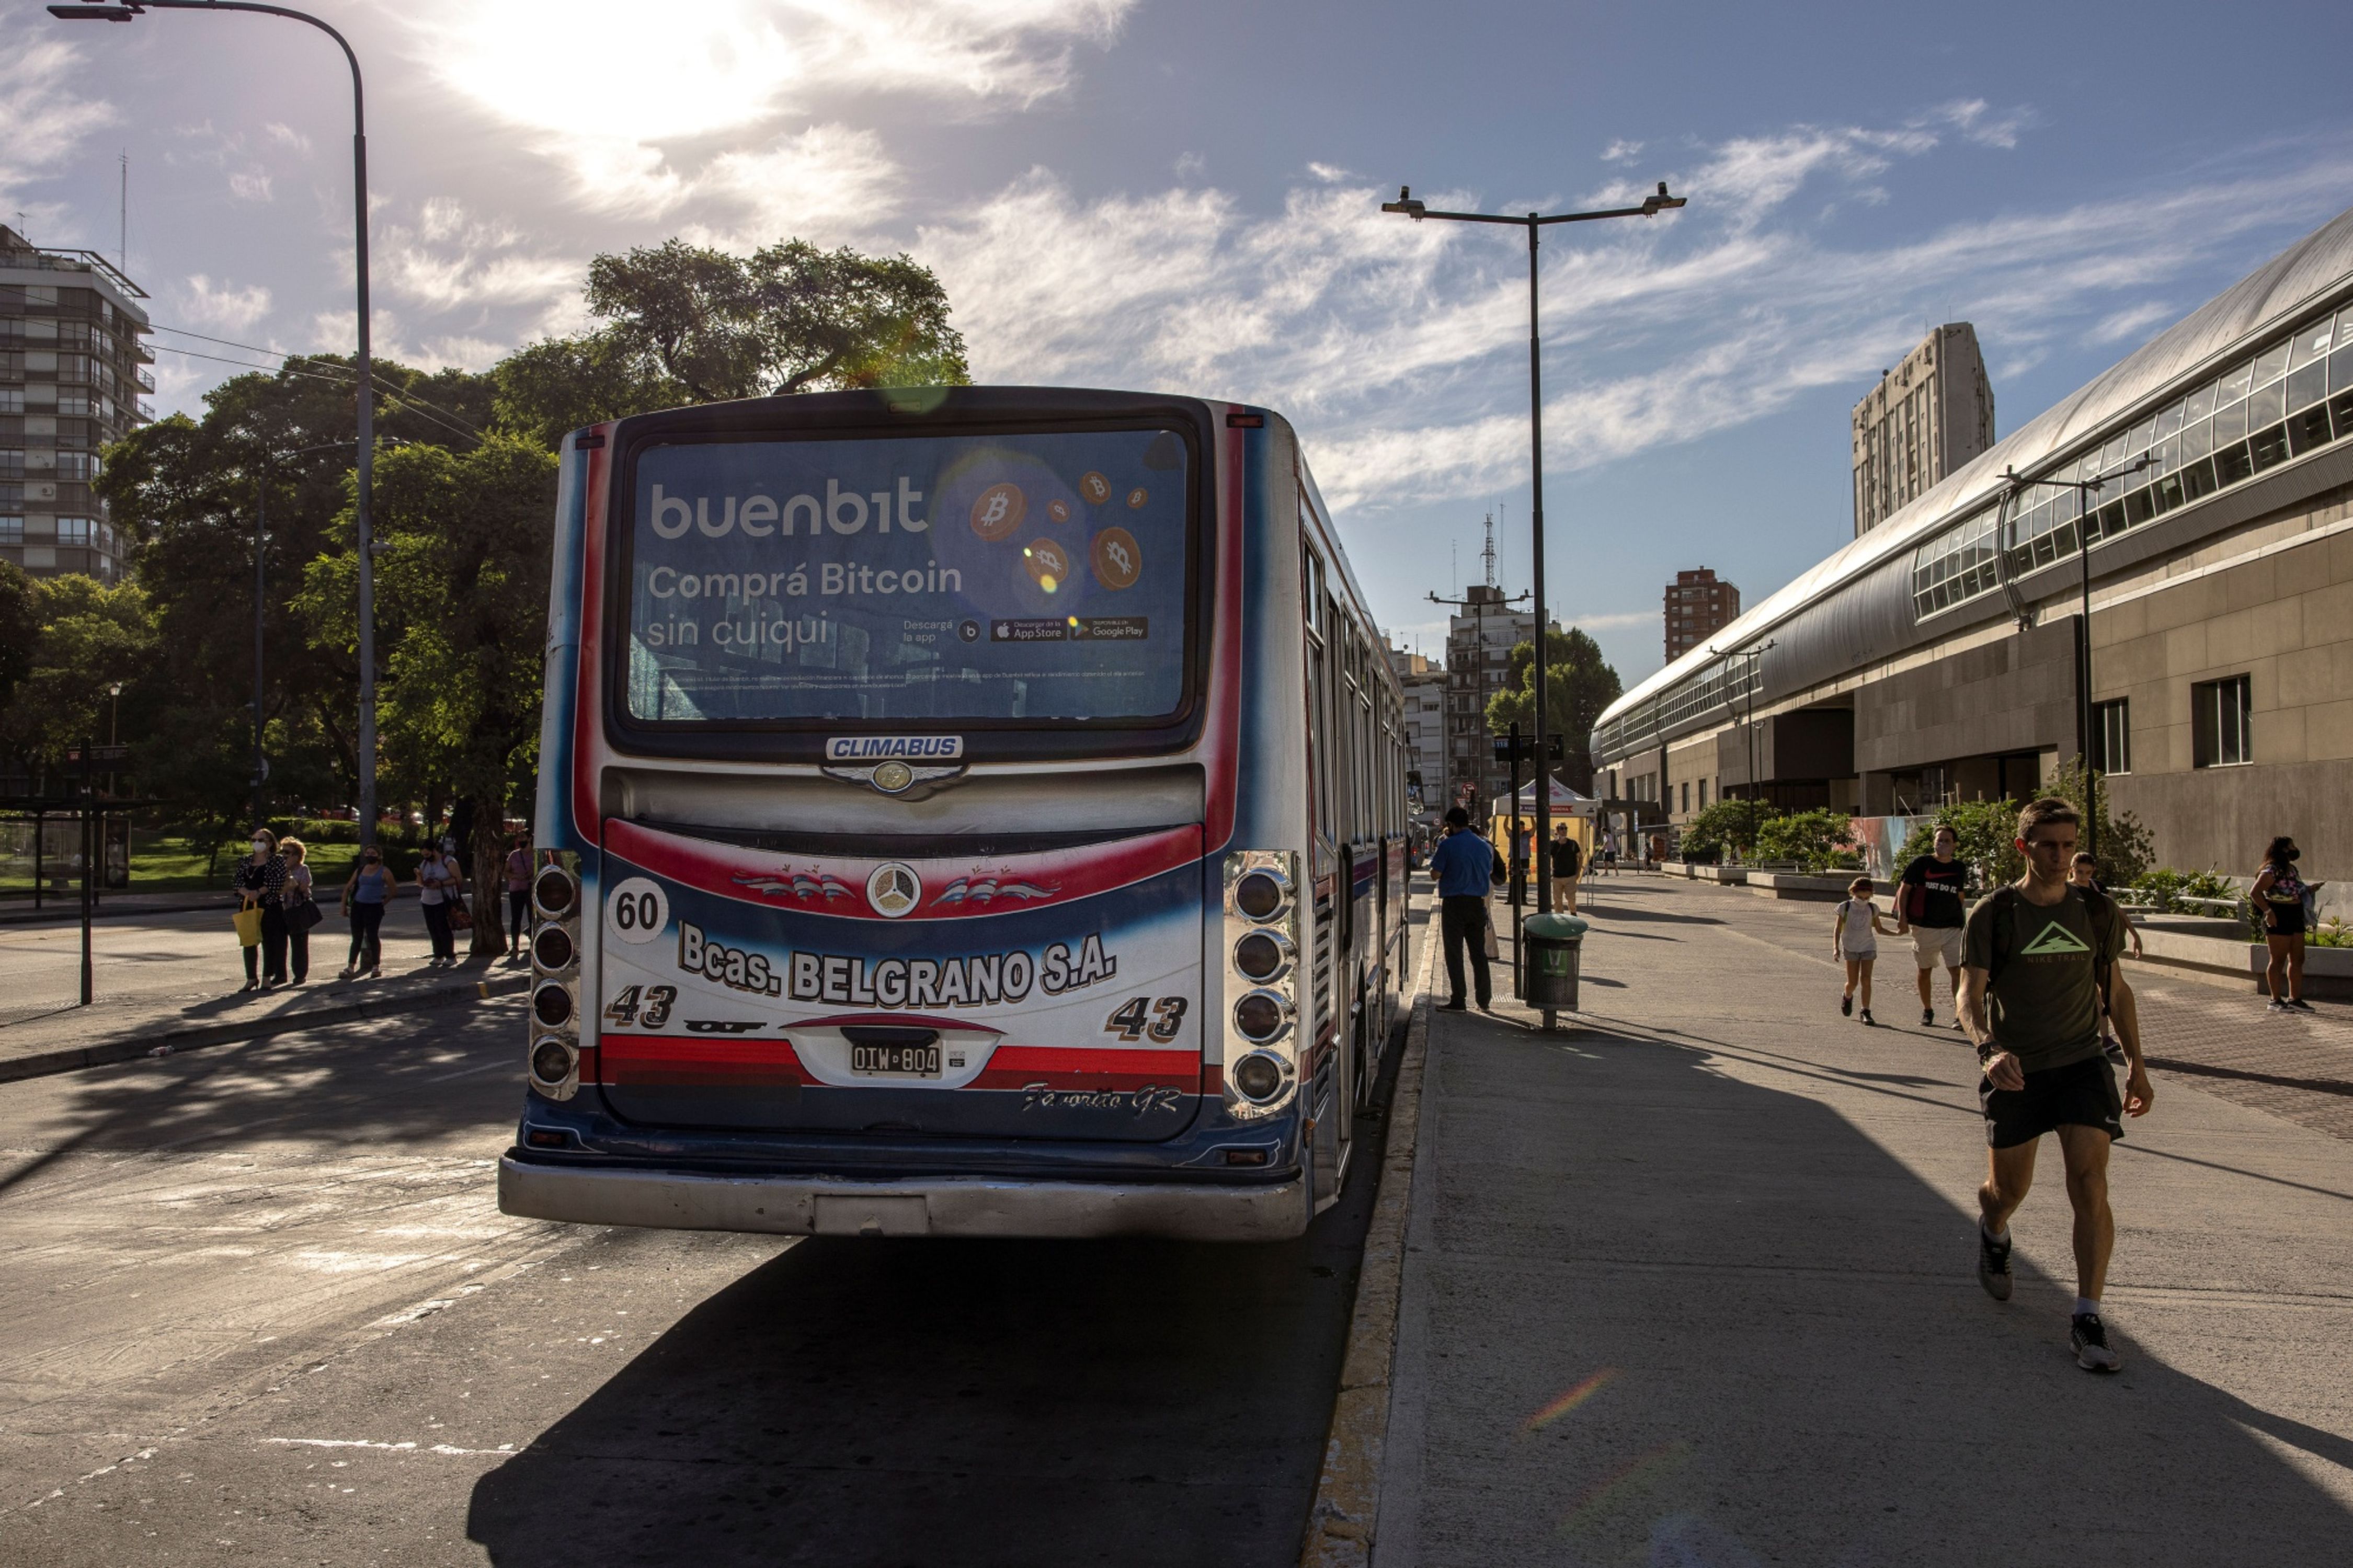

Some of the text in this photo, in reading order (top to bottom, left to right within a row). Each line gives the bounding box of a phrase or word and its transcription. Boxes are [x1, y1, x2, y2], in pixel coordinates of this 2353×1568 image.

[651, 476, 929, 539] buenbit
[648, 559, 962, 605] Comprá Bitcoin
[646, 610, 827, 653] sin cuiqui
[904, 619, 953, 632] Descargá
[904, 633, 936, 644] la app
[1014, 628, 1061, 639] App Store
[1093, 626, 1144, 637] Google Play
[833, 738, 956, 757] CLIMABUS
[1925, 882, 1939, 890] JUST
[1950, 885, 1957, 894] IT
[616, 891, 658, 930] 60
[679, 920, 1117, 1010] Bcas. BELGRANO S.A.
[2027, 954, 2086, 964] NIKE TRAIL
[604, 985, 678, 1030] 43
[1104, 996, 1189, 1044] 43
[854, 1047, 889, 1070] OIW
[902, 1048, 937, 1071] 804
[1132, 1083, 1182, 1120] GR
